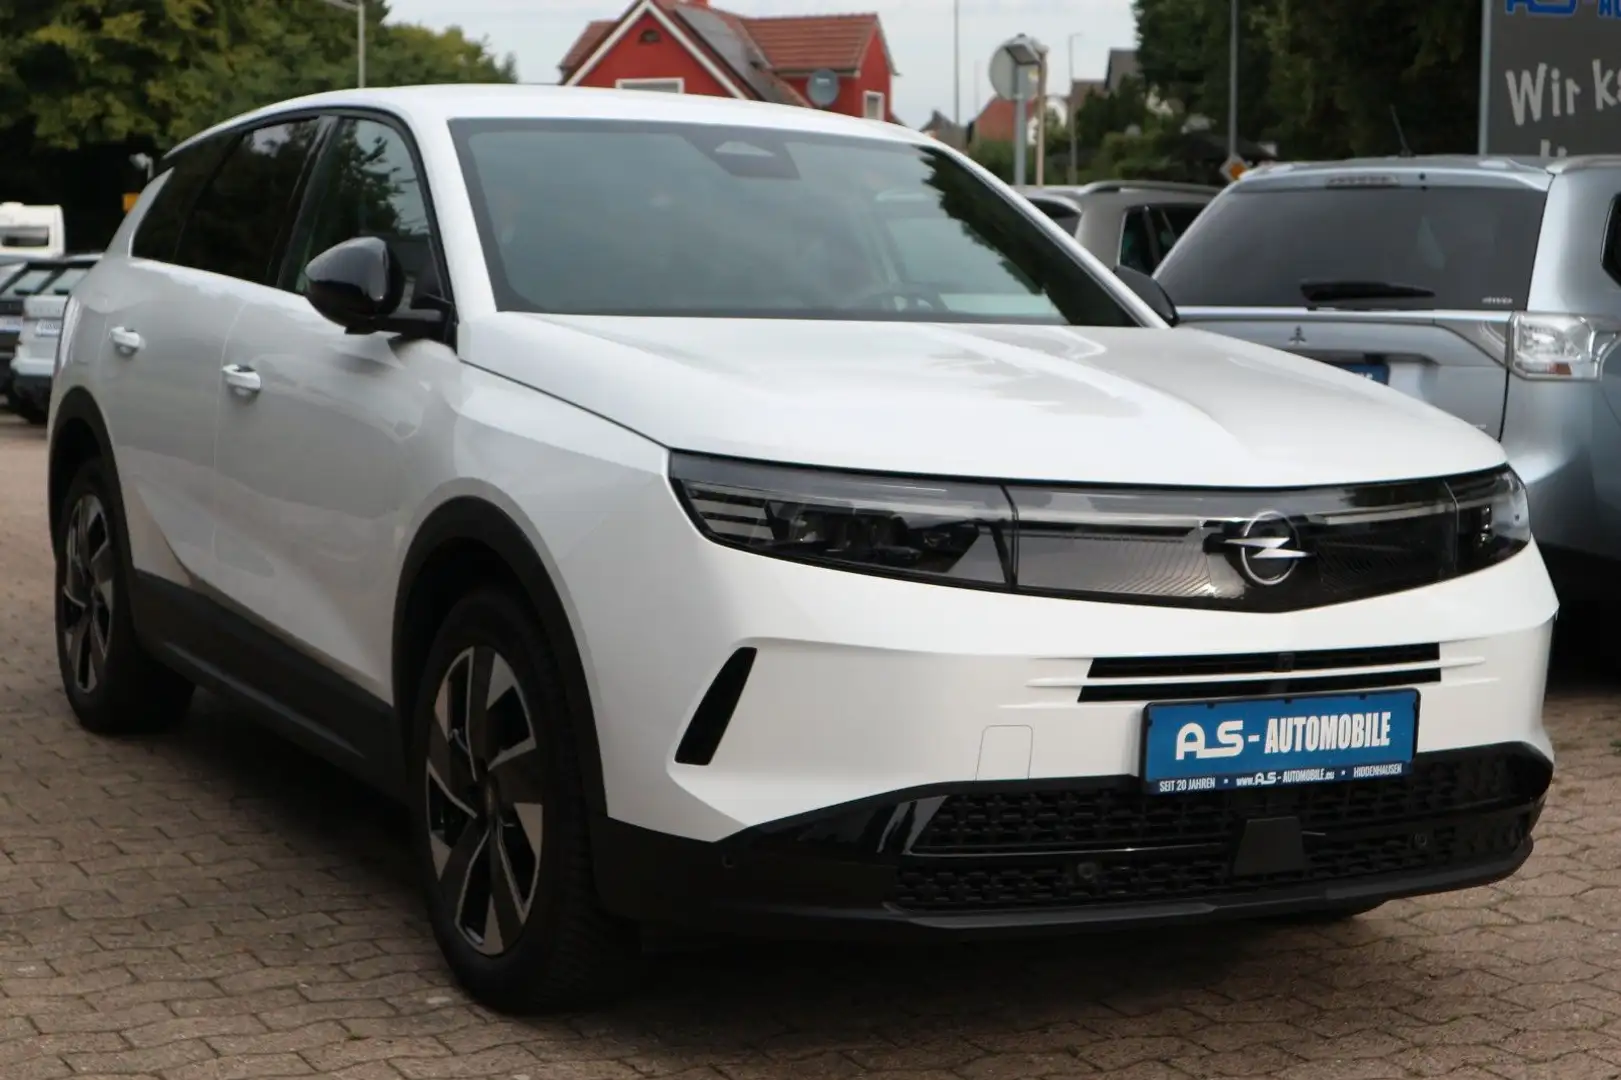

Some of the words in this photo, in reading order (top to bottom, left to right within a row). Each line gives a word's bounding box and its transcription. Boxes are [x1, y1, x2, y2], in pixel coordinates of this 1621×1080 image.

[1505, 62, 1581, 126] Wir
[1592, 59, 1621, 111] k
[1160, 780, 1174, 792] SEIT
[1176, 779, 1186, 791] 20
[1188, 777, 1216, 790] JAHREN
[1353, 763, 1402, 778] HIDDENHAUSEN
